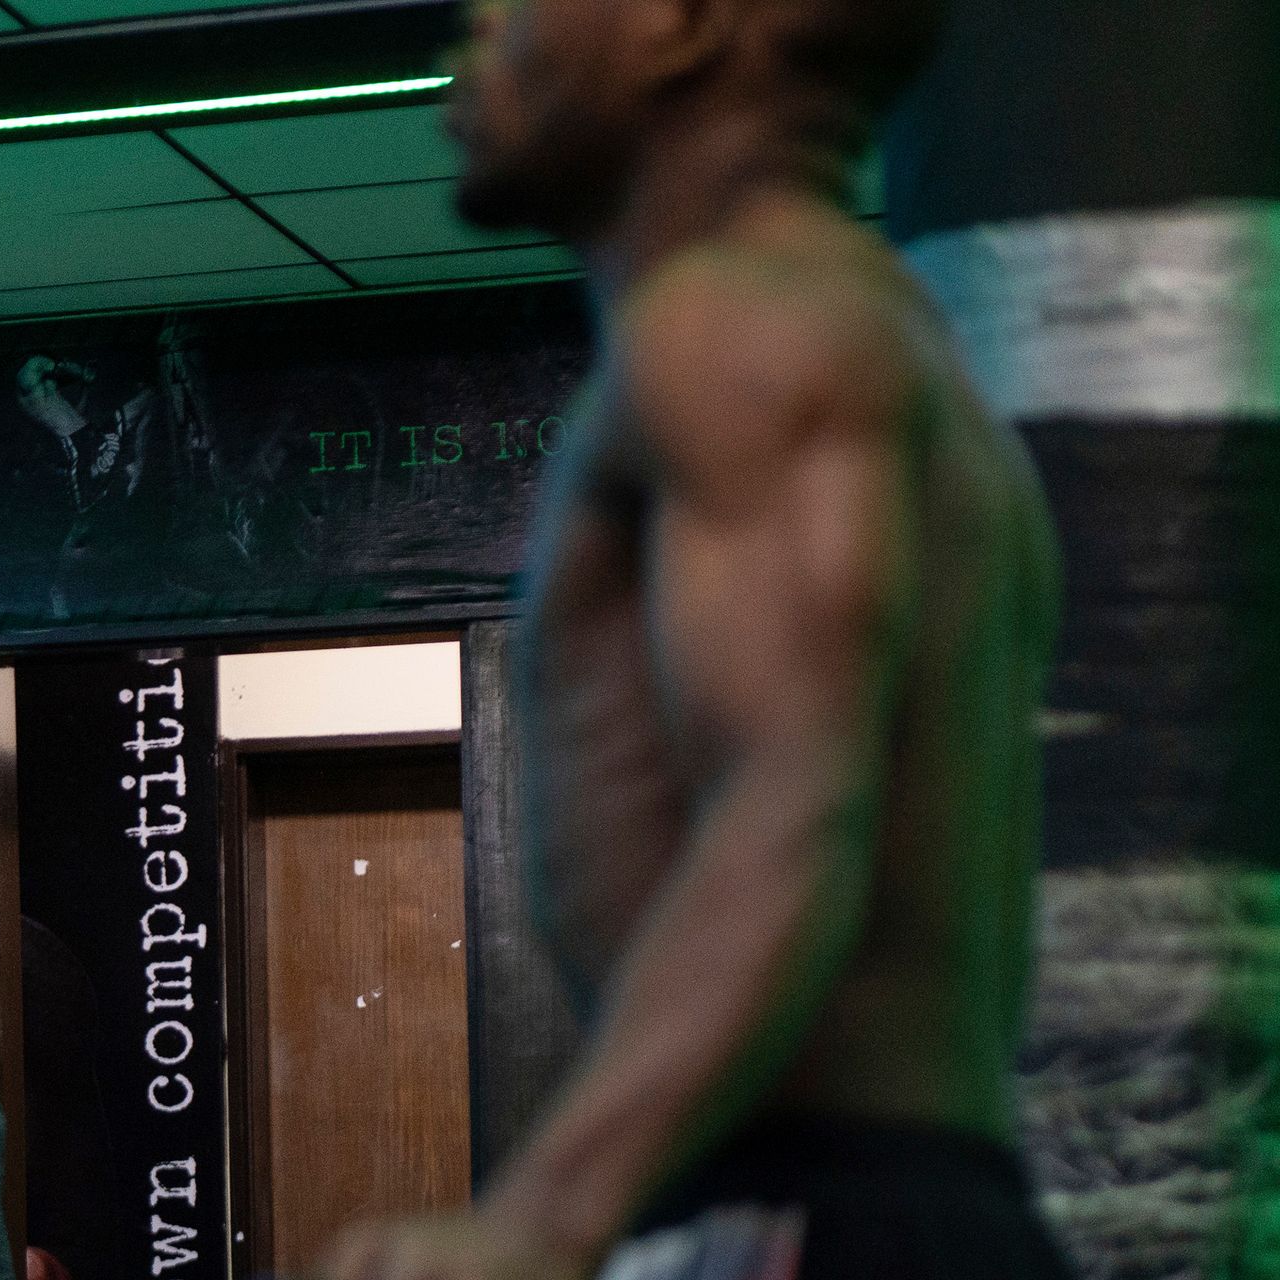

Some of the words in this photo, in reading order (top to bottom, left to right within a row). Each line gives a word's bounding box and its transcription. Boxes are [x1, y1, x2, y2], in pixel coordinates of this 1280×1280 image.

[307, 430, 373, 474] IT
[399, 423, 465, 468] IS
[119, 657, 207, 1113] competiti
